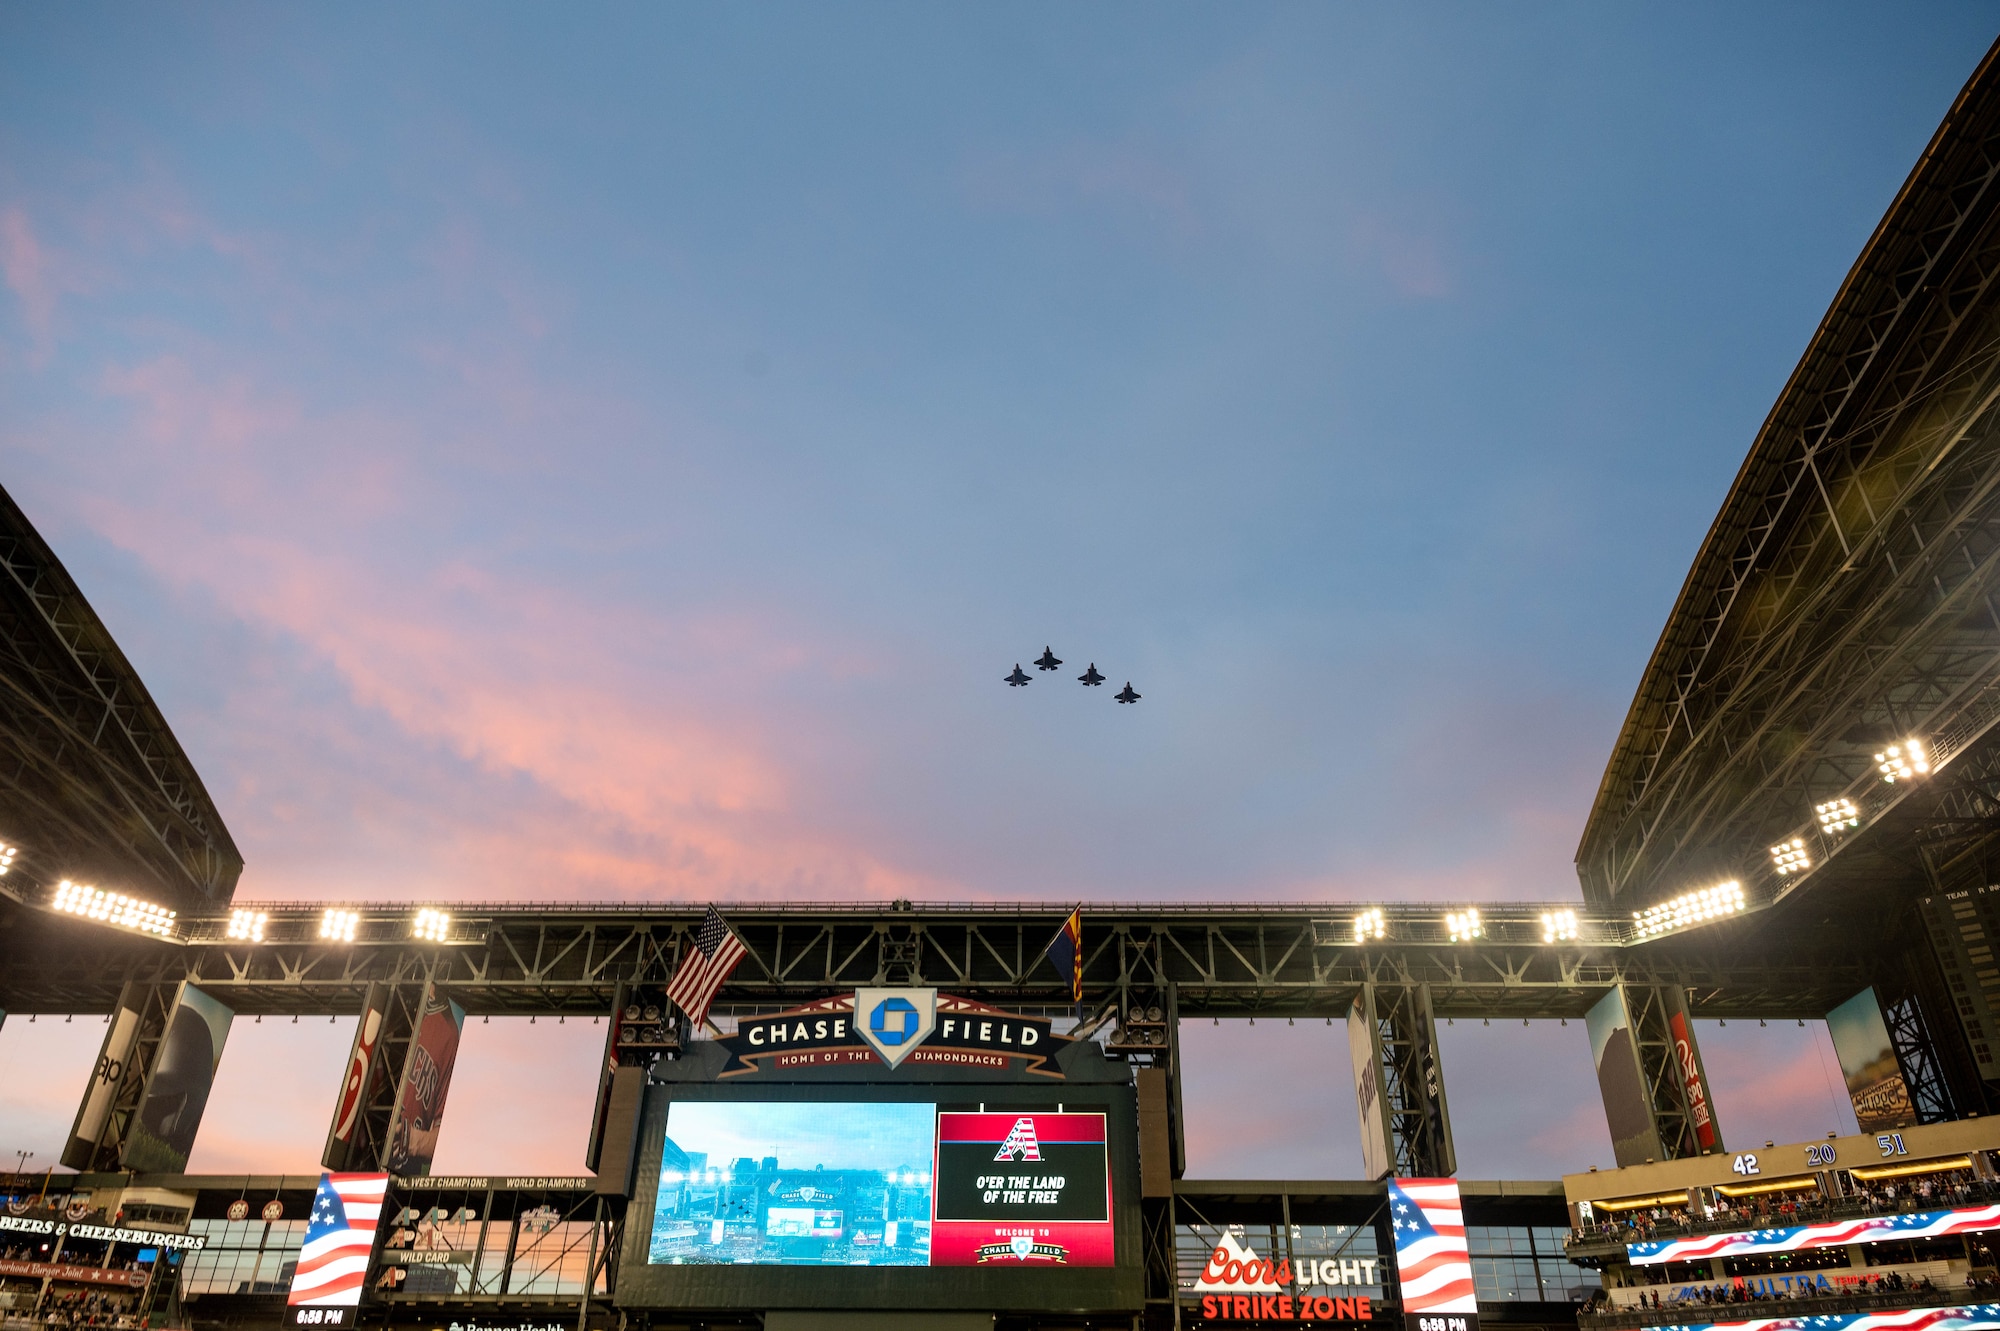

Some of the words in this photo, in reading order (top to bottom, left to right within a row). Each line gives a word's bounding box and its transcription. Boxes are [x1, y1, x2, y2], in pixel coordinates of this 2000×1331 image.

[1946, 890, 1969, 900] TEAM
[748, 1019, 846, 1046] CHASE
[942, 1019, 1039, 1046] FIELD
[781, 1054, 815, 1065] HOME
[824, 1053, 839, 1062] OF
[848, 1051, 870, 1061] THE
[914, 1052, 1003, 1066] DIAMONDBACKS
[1855, 1086, 1901, 1116] Slugger
[1877, 1133, 1908, 1157] 51
[1805, 1143, 1836, 1167] 20
[1732, 1154, 1760, 1176] 42
[397, 1178, 408, 1187] NL
[411, 1177, 435, 1187] WEST
[437, 1177, 488, 1187] CHAMPIONS
[506, 1178, 534, 1188] WORLD
[537, 1178, 586, 1188] CHAMPIONS
[976, 1175, 1004, 1189] O'ER
[1007, 1175, 1031, 1189] THE
[1033, 1175, 1065, 1189] LAND
[983, 1190, 1001, 1204] OF
[1003, 1190, 1026, 1204] THE
[1028, 1190, 1059, 1204] FREE
[0, 1216, 54, 1235] BEERS
[55, 1223, 67, 1236] &
[69, 1223, 206, 1250] CHEESEBURGERS
[995, 1228, 1035, 1237] WELCOME
[1039, 1228, 1050, 1236] TO
[983, 1245, 1010, 1254] CHASE
[1034, 1246, 1060, 1254] FIELD
[400, 1252, 423, 1263] WILD
[425, 1252, 450, 1263] CARD
[32, 1262, 60, 1277] Burger
[61, 1265, 84, 1279] Joint
[1201, 1247, 1294, 1286] Coors
[1295, 1259, 1376, 1286] LIGHT
[1747, 1273, 1832, 1297] ULTRA
[1202, 1295, 1294, 1320] STRIKE
[1298, 1295, 1372, 1320] ZONE
[296, 1309, 323, 1324] 6:58
[324, 1309, 344, 1324] PM
[1419, 1317, 1446, 1331] 6:58
[1447, 1317, 1467, 1331] PM
